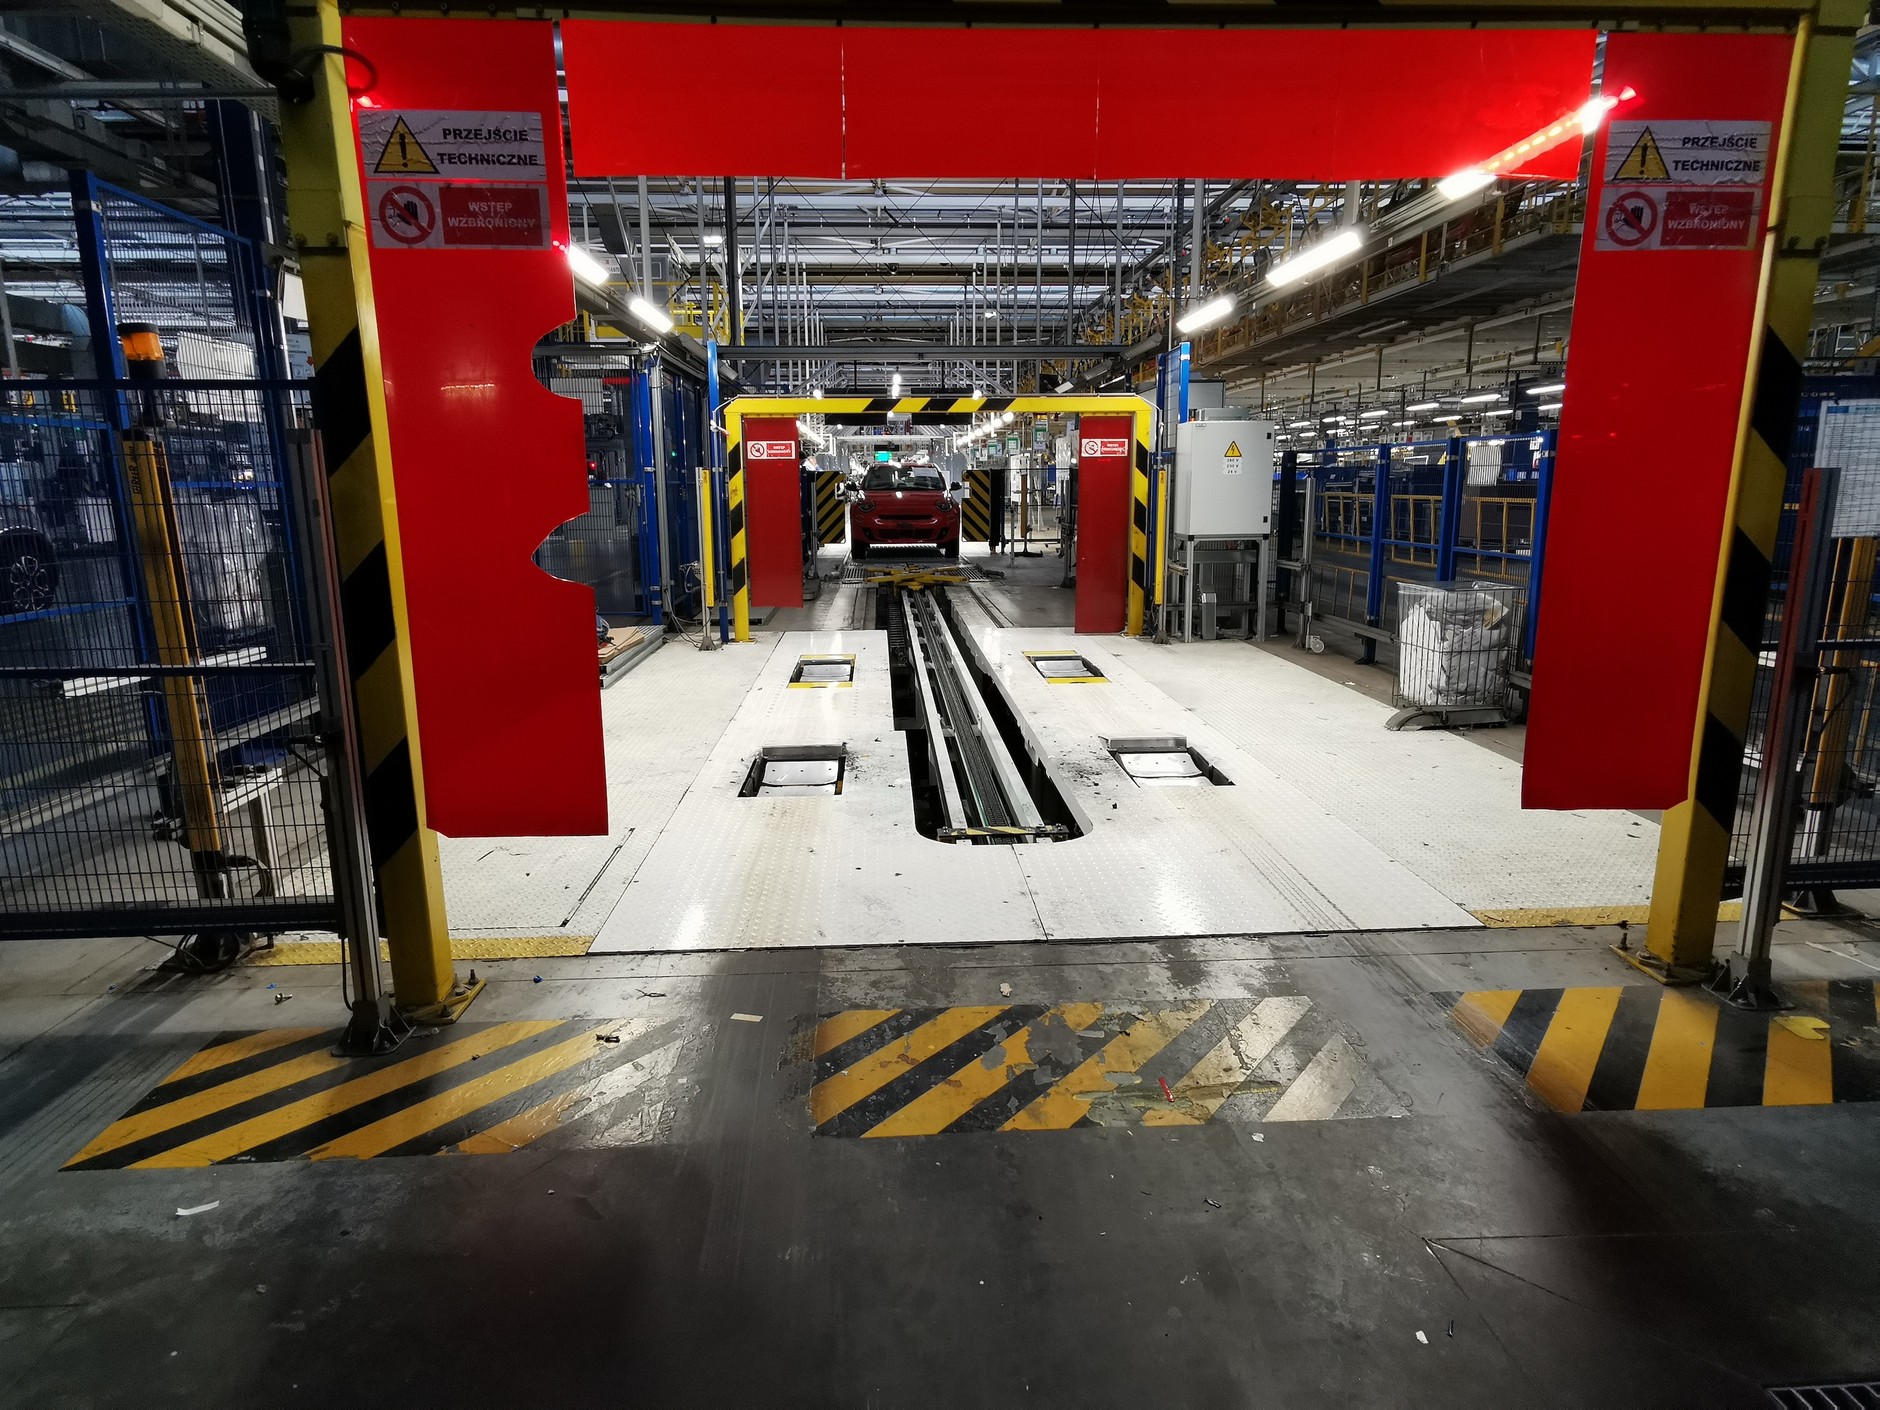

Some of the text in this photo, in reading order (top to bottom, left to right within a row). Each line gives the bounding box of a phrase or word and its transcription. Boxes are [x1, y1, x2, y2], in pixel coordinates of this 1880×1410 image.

[442, 126, 530, 142] PRZEJŚCIE
[1682, 135, 1758, 149] PRZEJŚCIE
[437, 152, 538, 166] TECHNICZNE
[1672, 159, 1761, 172] TECHNICZNE
[447, 217, 536, 229] WZBRONIONY
[1667, 219, 1745, 229] WZBRONIONY
